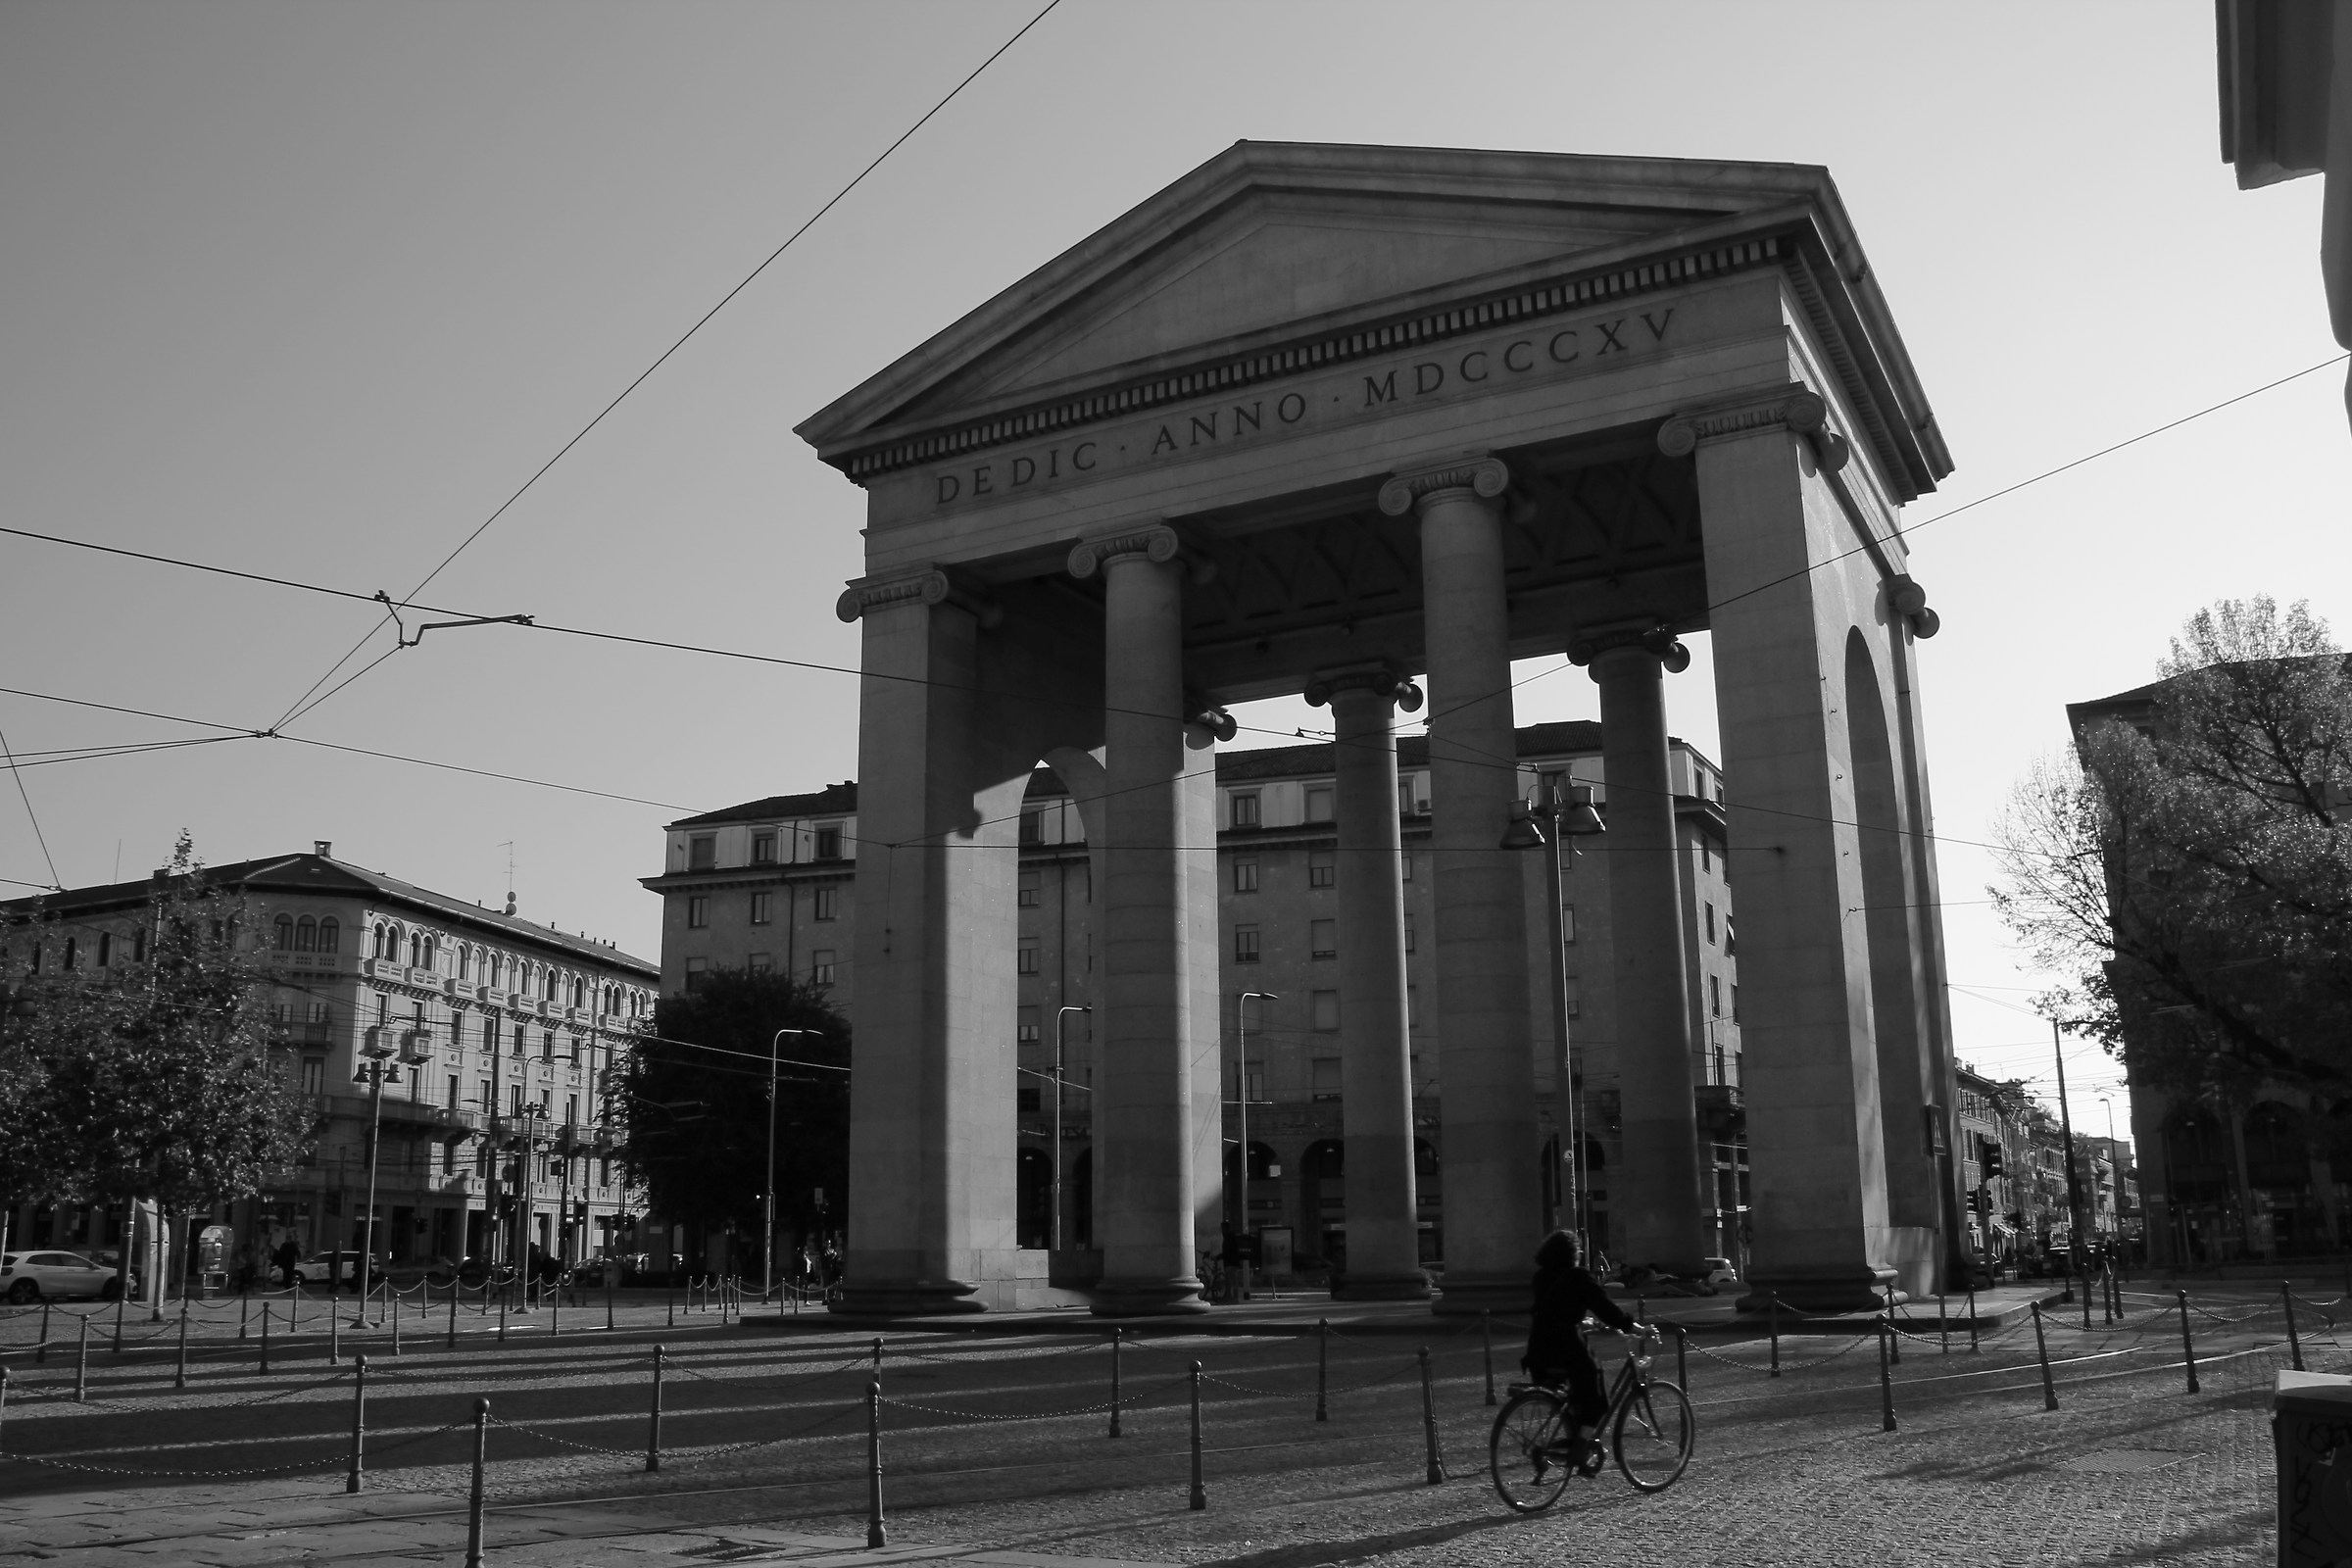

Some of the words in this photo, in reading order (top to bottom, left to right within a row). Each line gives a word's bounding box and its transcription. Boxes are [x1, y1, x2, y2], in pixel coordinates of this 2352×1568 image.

[935, 441, 1098, 505] DEDIC
[1151, 392, 1306, 456] ANNO
[1363, 308, 1675, 407] MDCCCXV
